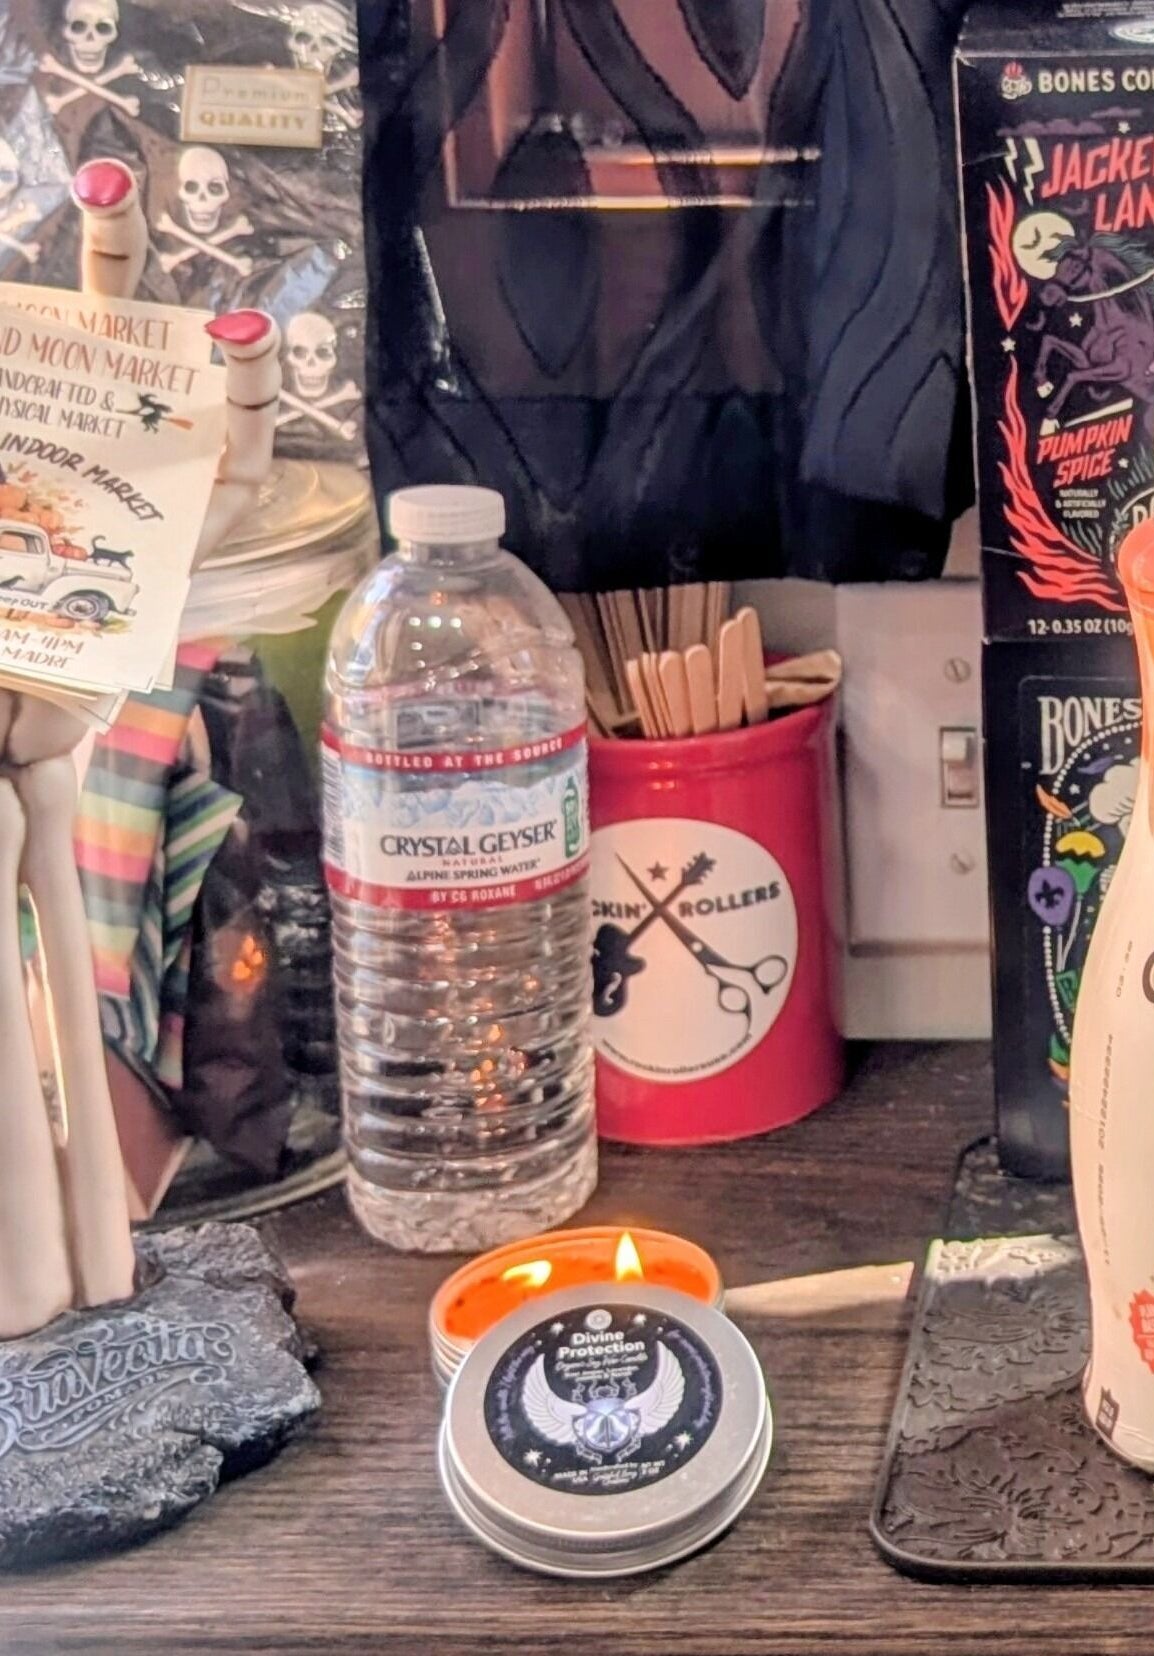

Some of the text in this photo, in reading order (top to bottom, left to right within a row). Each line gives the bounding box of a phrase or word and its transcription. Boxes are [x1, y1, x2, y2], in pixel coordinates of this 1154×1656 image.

[1039, 67, 1115, 93] BONES
[200, 111, 306, 129] QUALITY
[27, 333, 97, 374] MOON
[101, 350, 200, 396] MARKET
[0, 367, 115, 412] NDCRAFTED &
[59, 408, 126, 439] MARKET
[1037, 413, 1133, 465] PUMPKIN
[0, 432, 164, 521] INDOOR MARKET
[1053, 449, 1116, 488] SPICE
[1052, 619, 1081, 635] 0.35
[1084, 619, 1102, 635] OZ
[1037, 696, 1143, 776] BONES
[366, 737, 563, 769] BOTTLED AT THE SOURCE
[380, 822, 554, 857] CRYSTAL GEYSER
[406, 868, 449, 882] ALPINE
[453, 866, 498, 880] SPRING
[500, 861, 537, 877] WATER
[678, 881, 781, 919] ROLLERS
[557, 1341, 646, 1359] Protection
[571, 1331, 625, 1345] Divine
